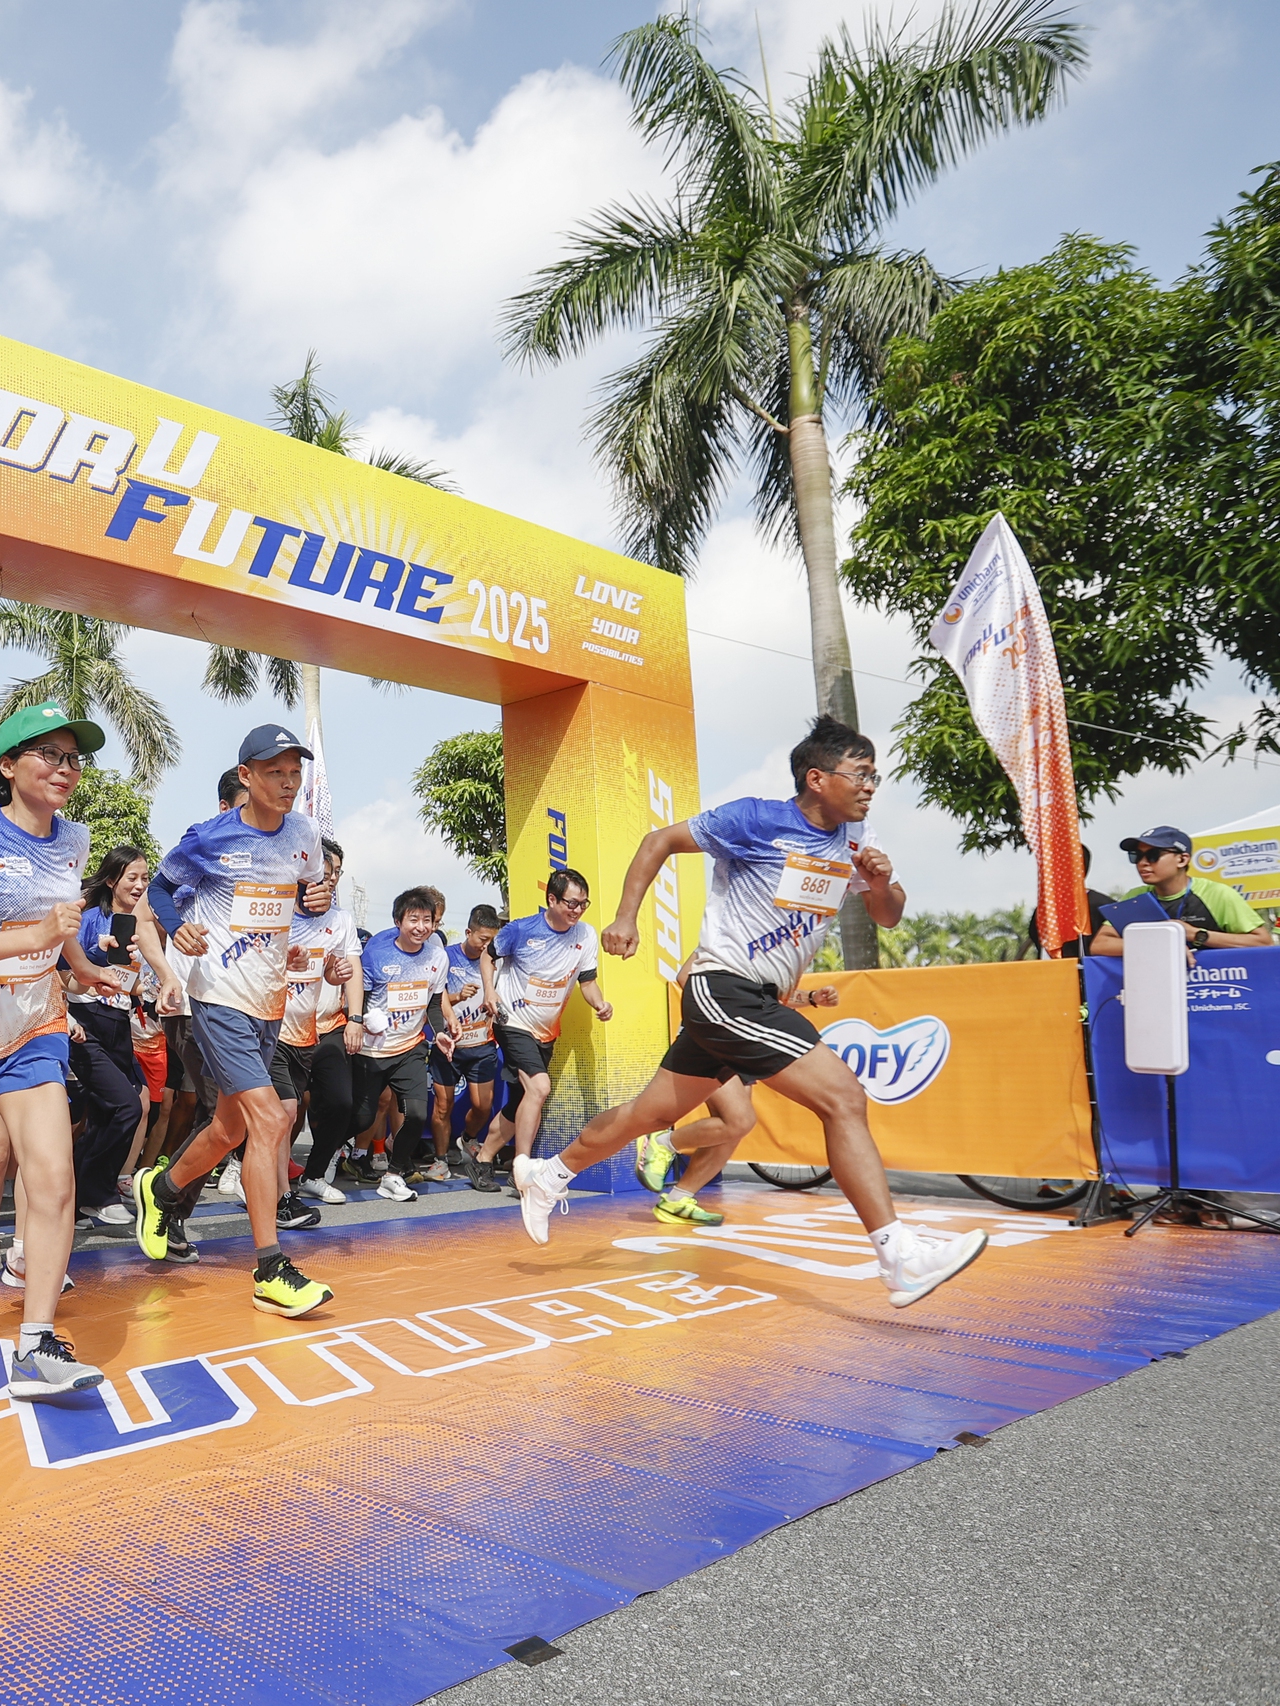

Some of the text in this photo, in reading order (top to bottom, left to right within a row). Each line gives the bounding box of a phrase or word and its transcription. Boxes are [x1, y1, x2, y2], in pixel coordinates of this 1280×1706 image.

[104, 477, 550, 655] FUTURE 2025
[958, 553, 1002, 601] unicharm
[574, 574, 644, 615] LOVE
[590, 617, 640, 646] YOUR
[581, 641, 645, 667] POSSIBILITIES
[1220, 841, 1278, 857] unicharm
[801, 876, 832, 895] 8681
[249, 901, 282, 916] 8383
[1187, 965, 1248, 983] charm
[398, 992, 419, 1002] 8265
[1191, 1004, 1233, 1012] Unicharm
[826, 1043, 918, 1087] OFY
